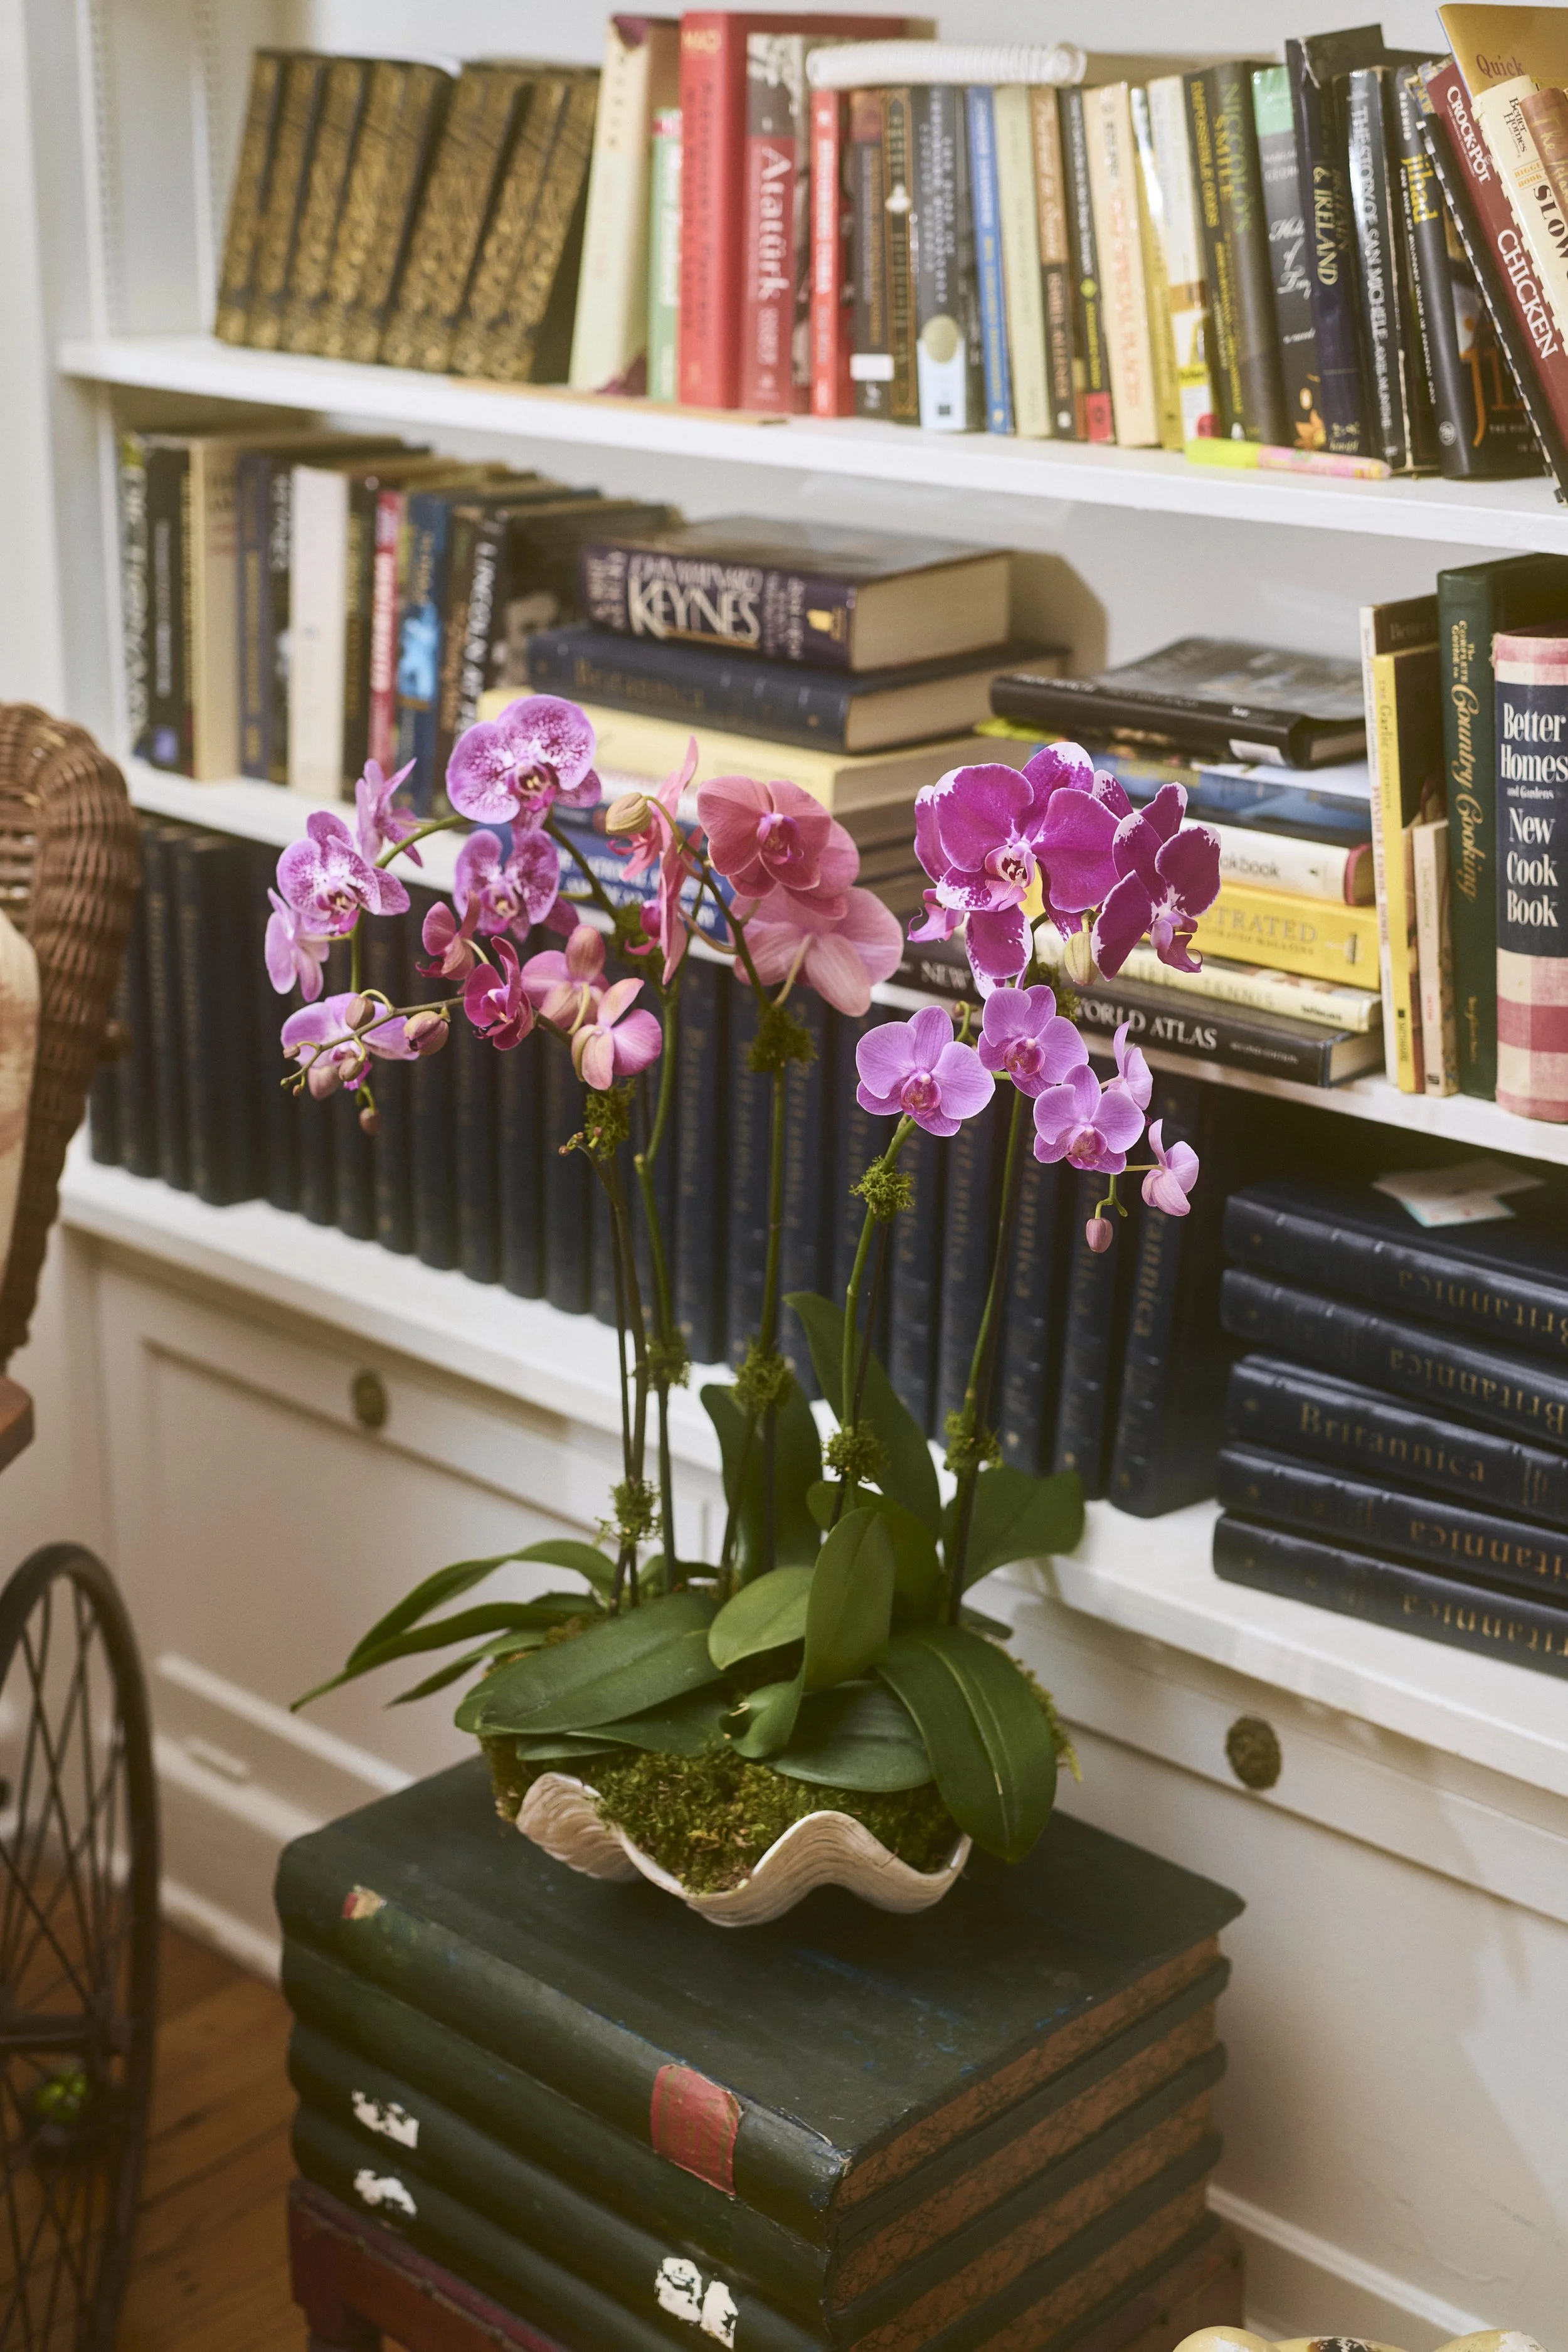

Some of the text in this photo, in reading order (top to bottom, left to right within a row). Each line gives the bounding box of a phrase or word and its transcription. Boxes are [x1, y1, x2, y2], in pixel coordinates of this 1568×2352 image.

[1476, 54, 1525, 78] Quick
[1352, 105, 1372, 145] THE
[1504, 112, 1527, 153] Homes
[1509, 97, 1527, 134] Better
[1357, 145, 1376, 199] STORY
[1400, 152, 1439, 225] jihad
[758, 146, 792, 300] Atatürk
[1313, 166, 1338, 286] & IRELAND
[1363, 200, 1379, 226] OF
[1365, 228, 1382, 265] SAN
[1366, 268, 1388, 341] MICHELE
[1497, 229, 1559, 359] CHICKEN
[628, 576, 761, 644] KEYNES
[1379, 704, 1394, 748] Garlic
[1503, 702, 1567, 743] Better
[1500, 743, 1568, 783] Homes
[1451, 683, 1486, 904] Country Cooking
[1507, 785, 1555, 801] and Gardens
[1508, 807, 1557, 845] New
[1220, 852, 1280, 879] okbook
[1507, 850, 1559, 887] Cook
[1202, 905, 1317, 943] STRATED
[1507, 889, 1559, 928] Book
[921, 960, 970, 991] NEW
[1078, 997, 1218, 1051] ORLD ATLAS
[1134, 1208, 1168, 1338] tannica
[1388, 1346, 1567, 1435] Britannica
[1300, 1401, 1486, 1484] Britannica
[1410, 1518, 1568, 1589] itannica
[1402, 1594, 1568, 1660] ritannica
